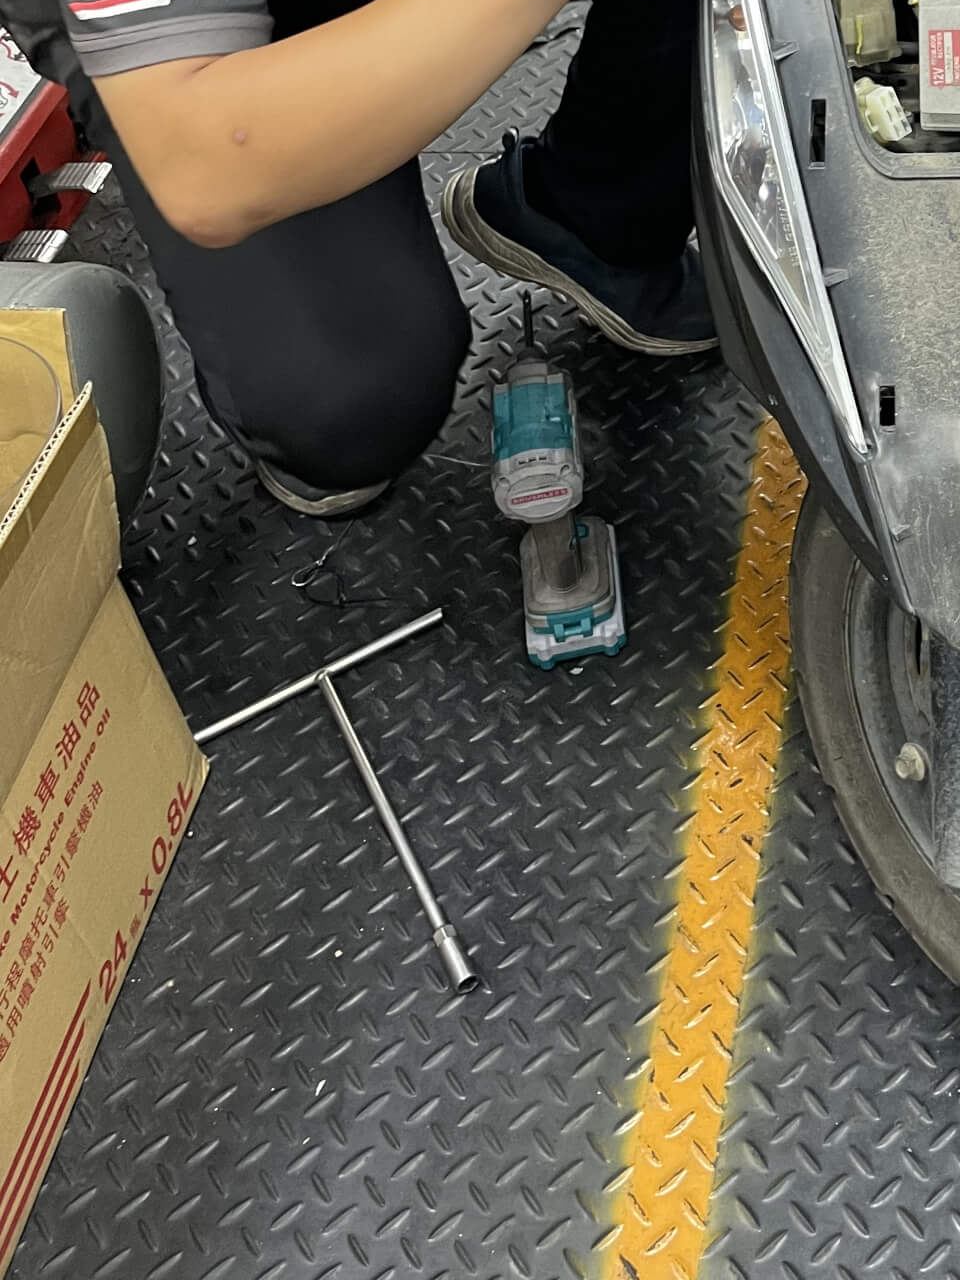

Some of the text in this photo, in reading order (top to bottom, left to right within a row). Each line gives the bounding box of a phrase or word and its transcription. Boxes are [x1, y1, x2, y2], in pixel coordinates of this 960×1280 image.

[932, 67, 944, 85] 12V
[10, 811, 64, 925] Motorcycle
[63, 741, 97, 808] Engine
[96, 707, 110, 736] Oil
[99, 929, 128, 1005] 24
[151, 780, 194, 875] 0.8L
